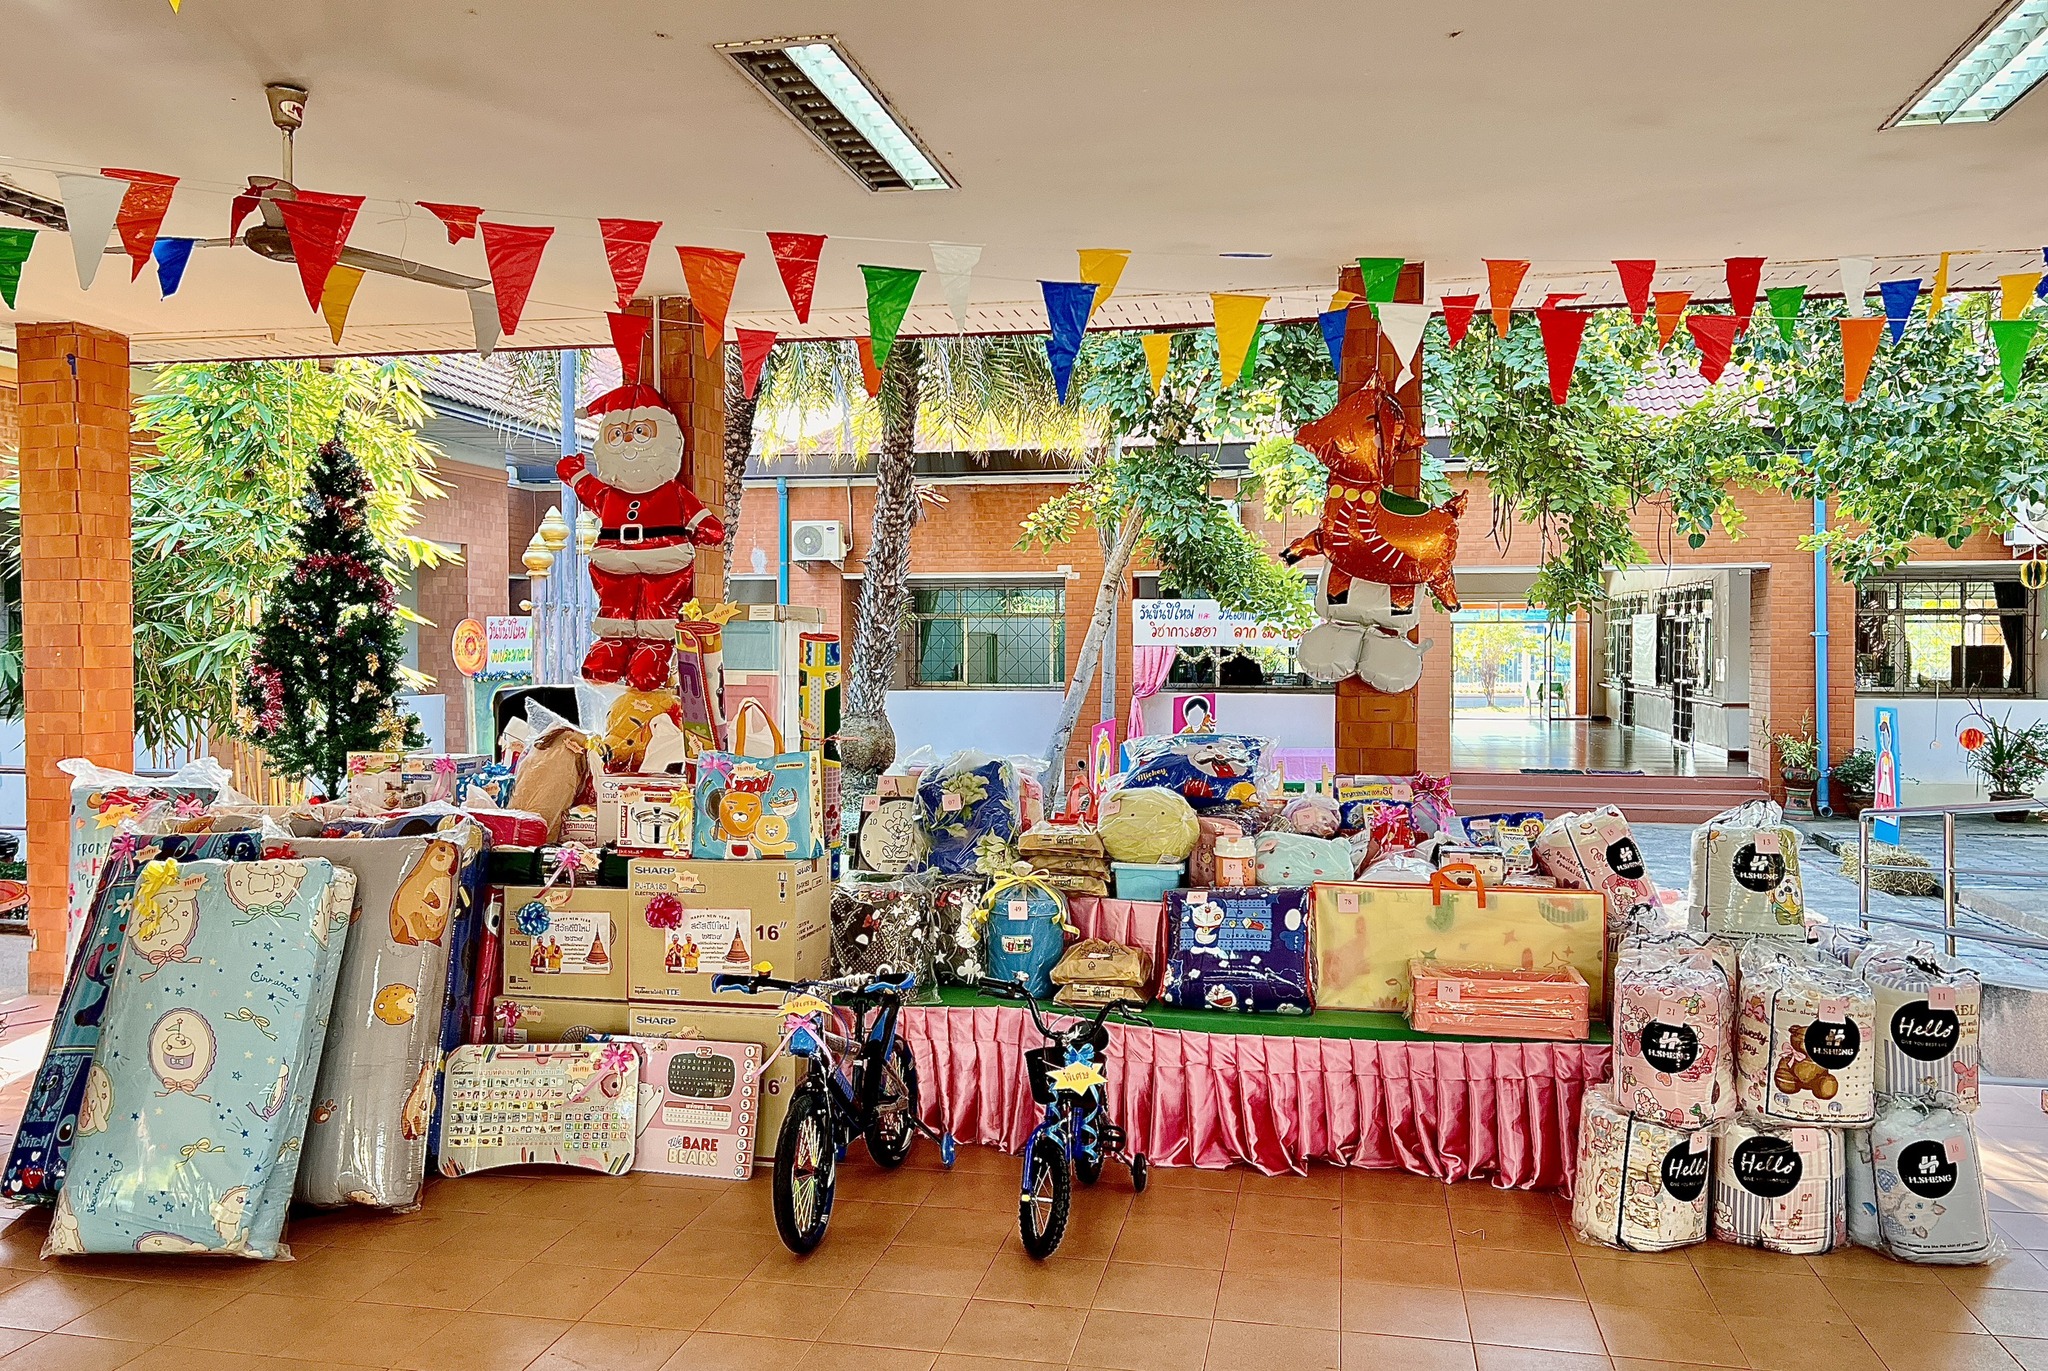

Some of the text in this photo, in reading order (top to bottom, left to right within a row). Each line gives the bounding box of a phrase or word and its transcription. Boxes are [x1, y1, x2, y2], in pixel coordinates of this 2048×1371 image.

[1139, 601, 1195, 620] วันขึ้นปีใหม่
[1523, 824, 1540, 835] 99
[1762, 838, 1772, 846] 13
[76, 842, 108, 857] FROM
[635, 866, 676, 874] SHARP
[1445, 985, 1455, 993] 76
[1937, 992, 1947, 1001] 11
[1666, 1007, 1676, 1016] 21
[1827, 1005, 1837, 1014] 22
[636, 1015, 677, 1025] SHARP
[1899, 1016, 1954, 1038] Hello
[1064, 1071, 1089, 1082] พิเศษ
[1800, 1134, 1809, 1142] 31
[682, 1136, 719, 1152] BARE
[1951, 1144, 1960, 1152] 16
[667, 1147, 718, 1167] BEARS
[1741, 1153, 1795, 1174] Hello
[1908, 1174, 1952, 1184] H.SHENG
